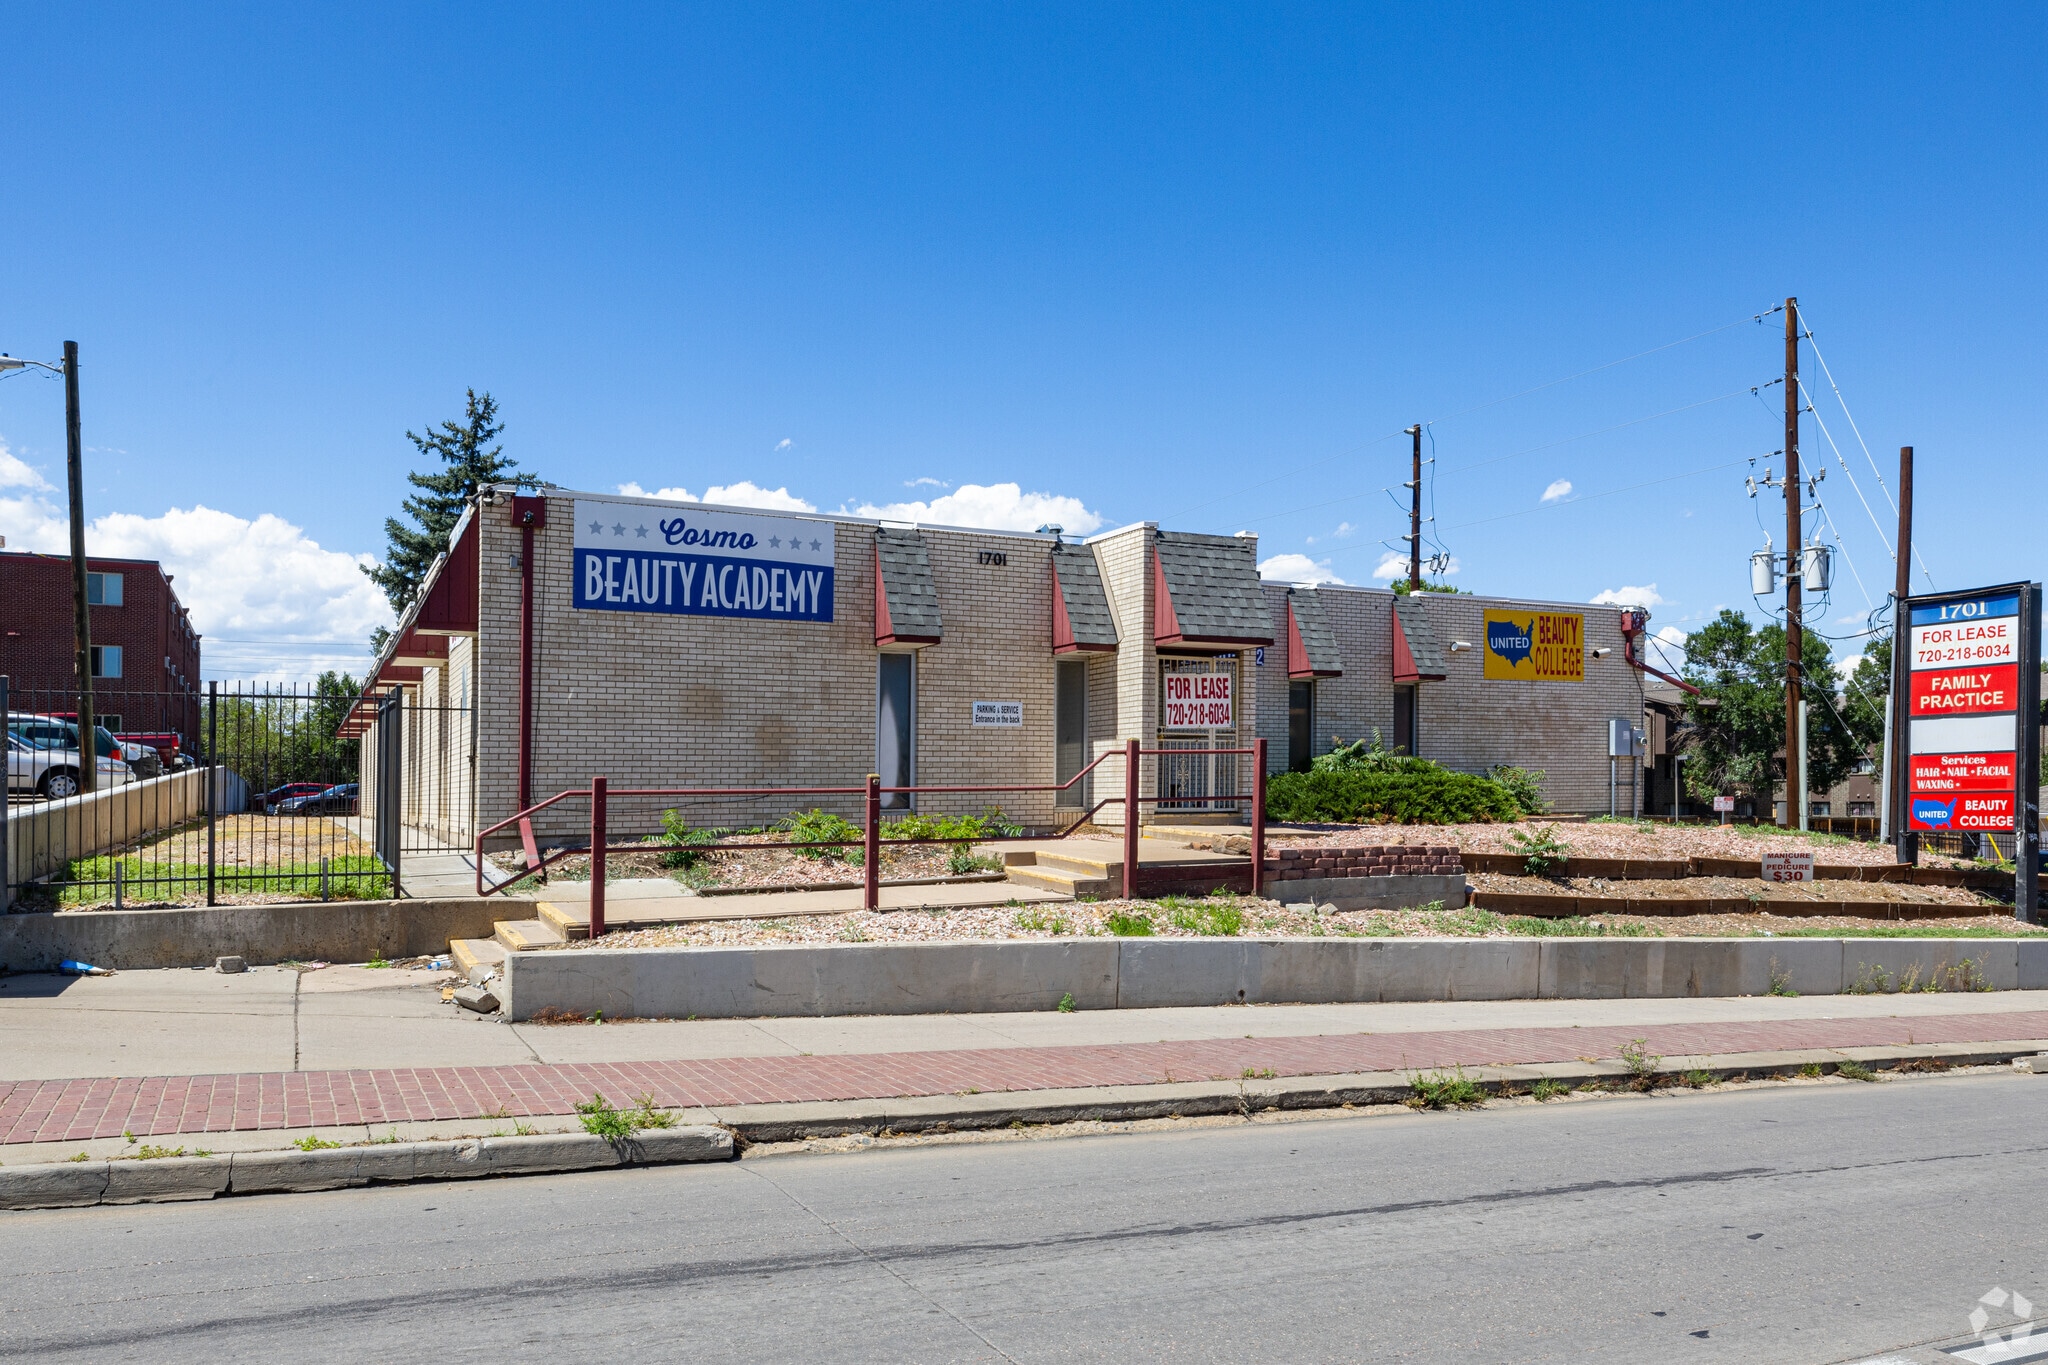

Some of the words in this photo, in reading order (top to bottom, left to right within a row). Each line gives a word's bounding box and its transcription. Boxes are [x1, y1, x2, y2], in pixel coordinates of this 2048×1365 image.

[660, 517, 758, 550] Cosmo
[979, 552, 1007, 566] 1701
[585, 555, 697, 607] BEAUTY
[700, 563, 824, 614] ACADEMY
[1939, 601, 1987, 620] 1701
[1538, 615, 1579, 645] BEAUTY
[1922, 630, 1952, 644] FOR
[1957, 625, 2007, 641] LEASE
[1490, 637, 1530, 649] UNITED
[1918, 644, 2011, 663] 720-218-6034
[1535, 647, 1581, 676] COLLEGE
[1167, 677, 1191, 699] FOR
[1195, 677, 1229, 699] LEASE
[1931, 674, 1992, 691] FAMILY
[1920, 691, 2004, 709] PRACTICE
[976, 705, 996, 714] PARKING
[1001, 706, 1018, 714] SERVICE
[1167, 703, 1230, 725] 720-218-6034
[976, 714, 995, 722] Entrance
[1941, 755, 1987, 765] Services
[1916, 768, 1940, 777] HAIR
[1947, 767, 1970, 777] NAIL
[1976, 766, 2011, 777] FACIAL
[1916, 779, 1954, 789] WAXING
[1965, 800, 2008, 811] BEAUTY
[1919, 811, 1948, 819] UNITED
[1959, 815, 2014, 827] COLLEGE
[1773, 871, 1803, 882] $30
